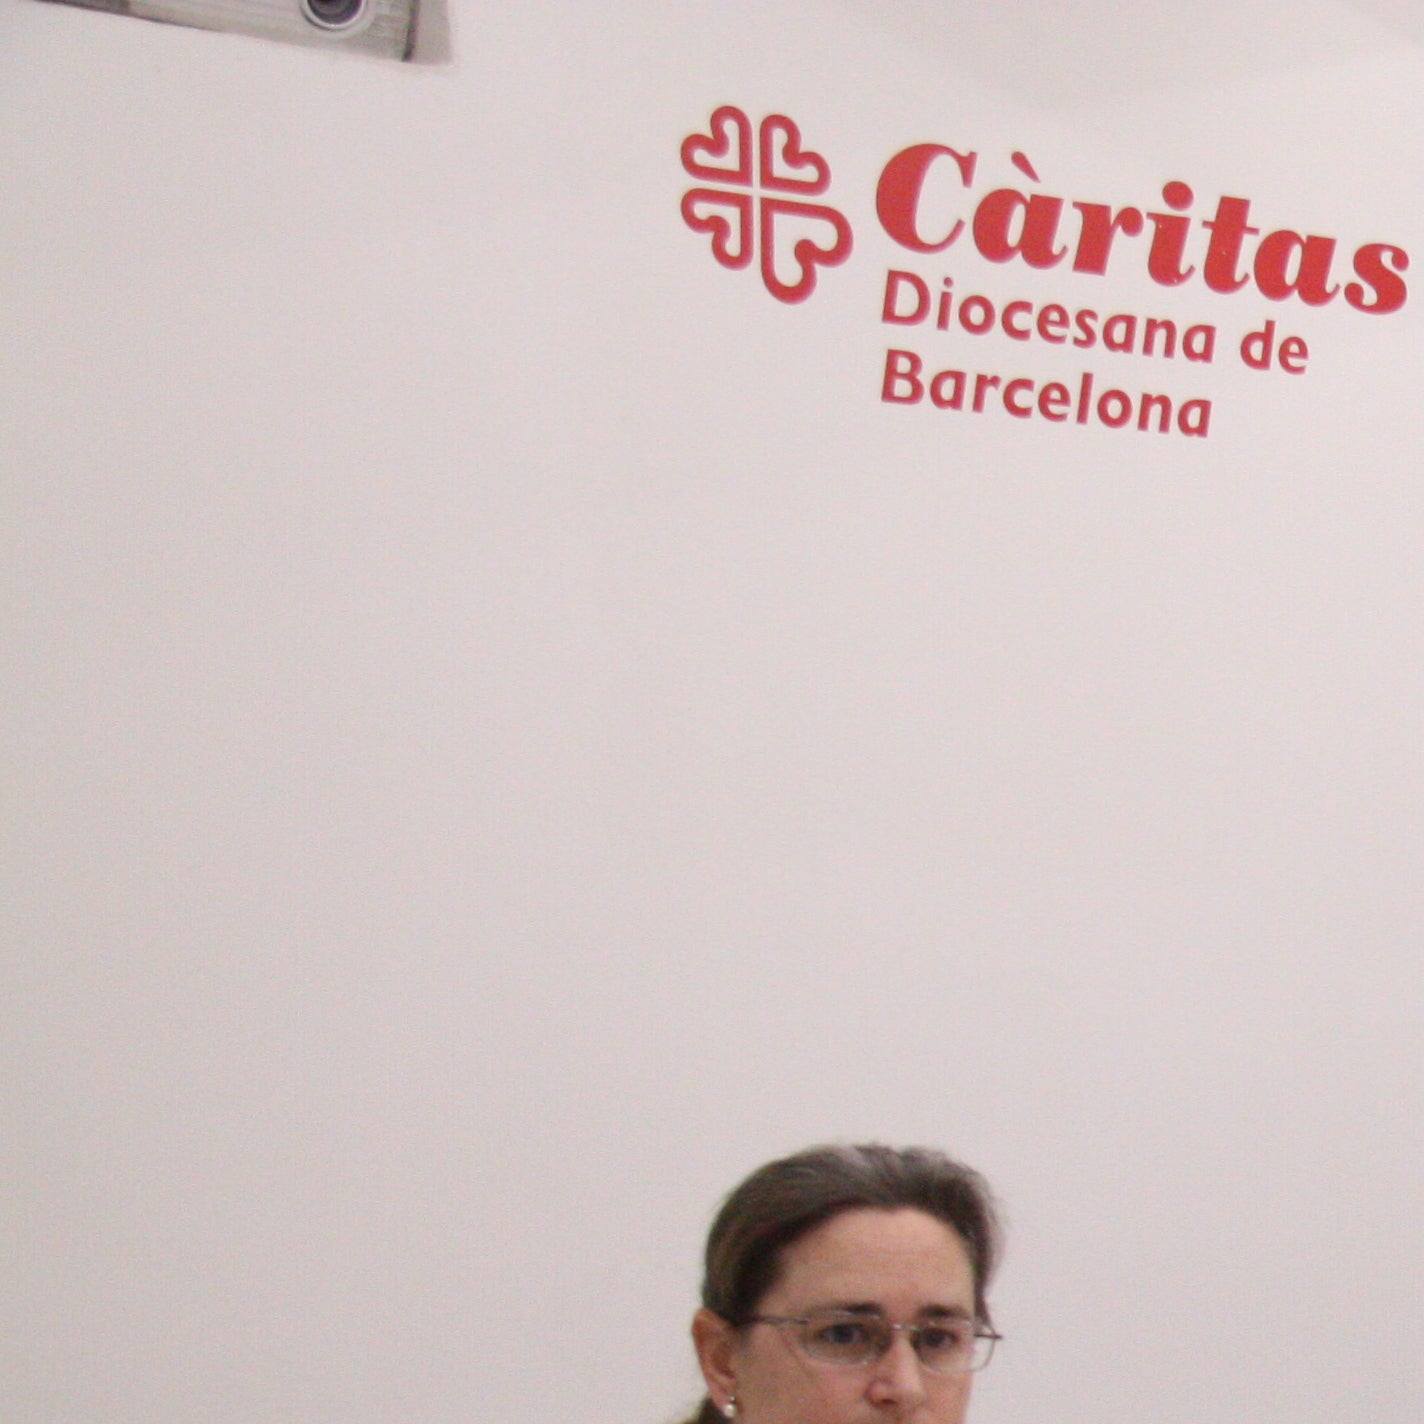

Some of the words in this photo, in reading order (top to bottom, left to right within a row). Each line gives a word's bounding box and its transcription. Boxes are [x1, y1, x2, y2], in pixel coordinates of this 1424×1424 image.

[876, 141, 1410, 315] Càritas
[881, 269, 1215, 364] Diocesana
[1240, 319, 1309, 375] de
[881, 348, 1212, 438] Barcelona
